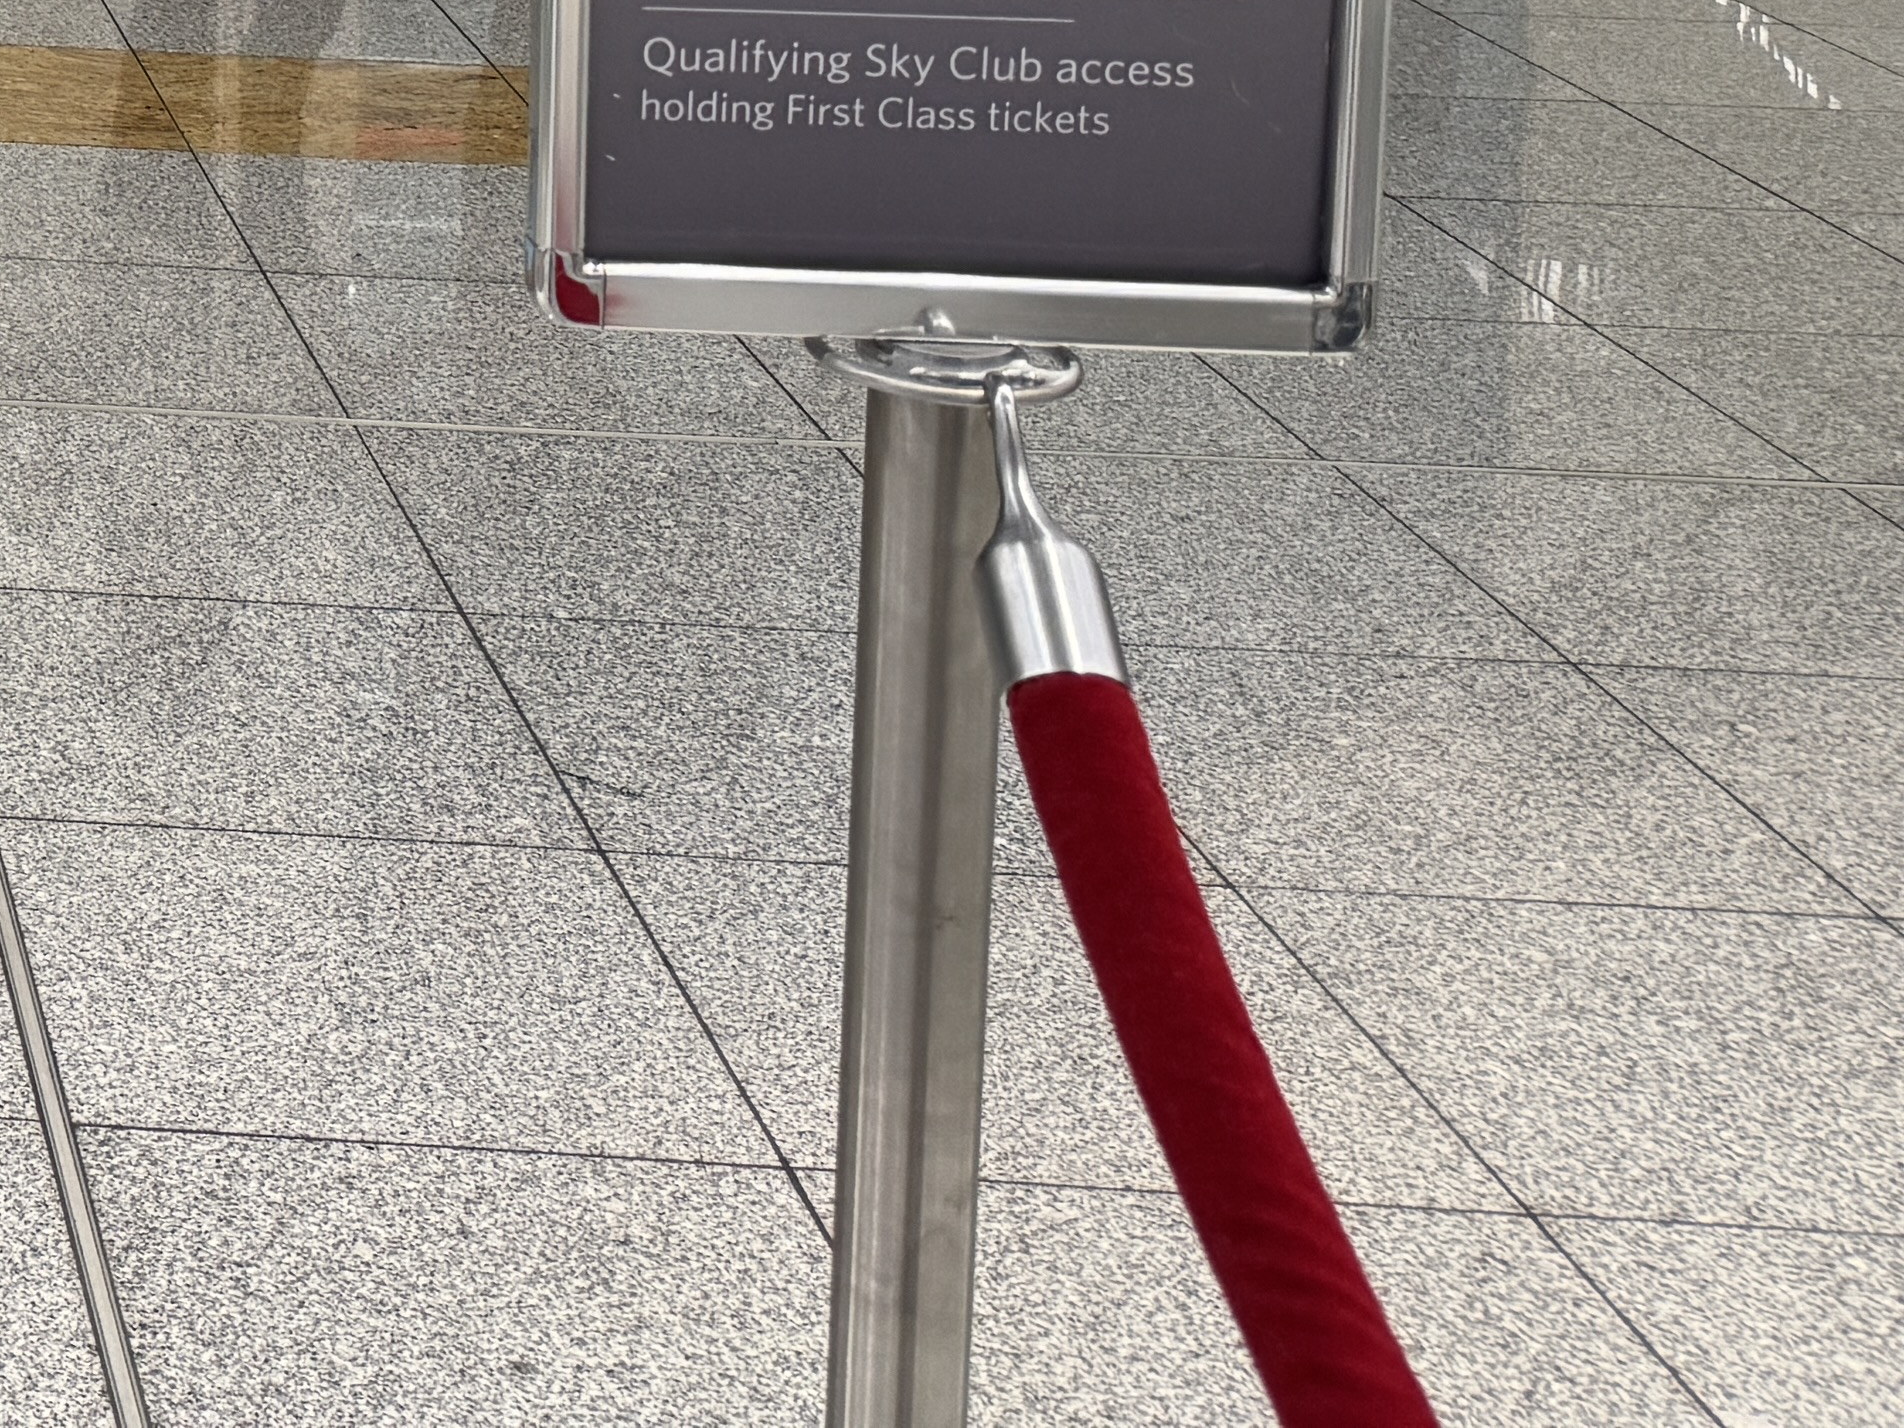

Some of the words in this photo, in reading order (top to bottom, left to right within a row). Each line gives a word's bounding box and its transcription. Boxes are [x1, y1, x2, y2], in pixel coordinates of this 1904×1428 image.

[641, 36, 852, 84] Qualifying
[864, 42, 936, 87] Sky
[949, 45, 1043, 83] Club
[1055, 58, 1195, 88] access
[640, 88, 775, 132] holding
[787, 93, 865, 128] First
[878, 95, 976, 131] Class
[987, 100, 1110, 136] tickets
